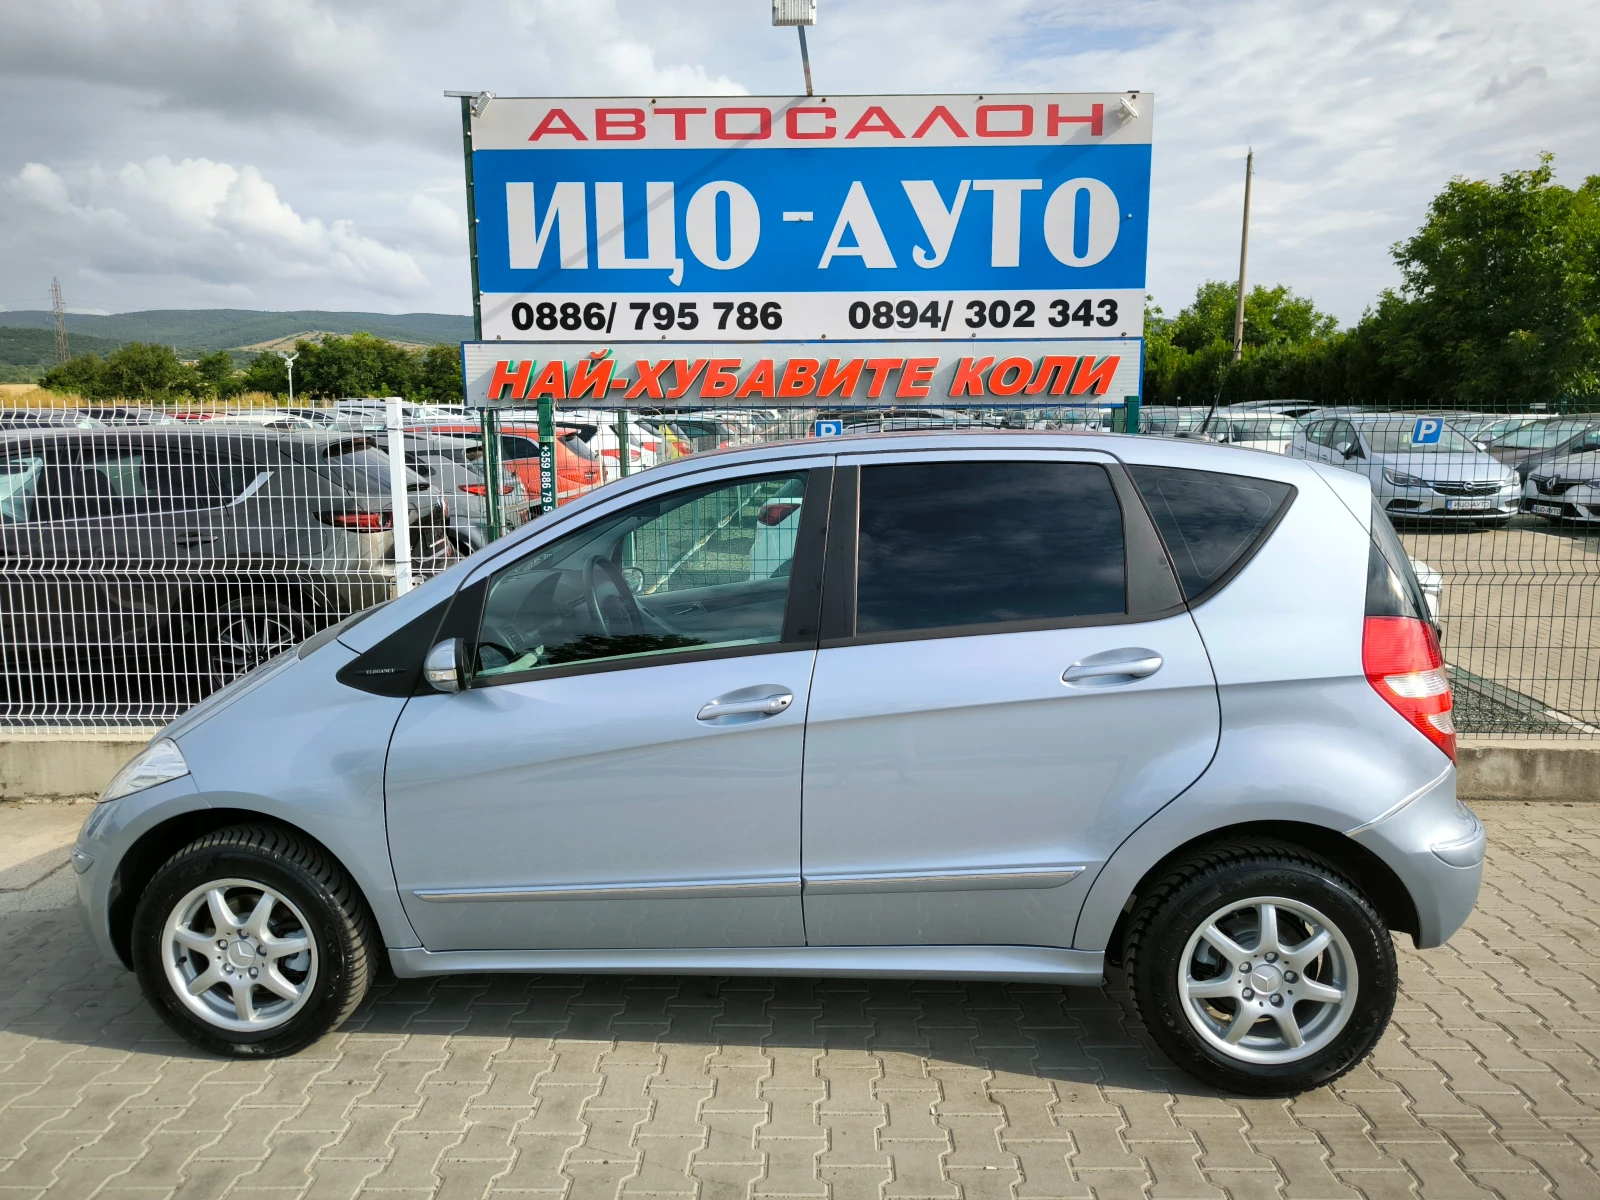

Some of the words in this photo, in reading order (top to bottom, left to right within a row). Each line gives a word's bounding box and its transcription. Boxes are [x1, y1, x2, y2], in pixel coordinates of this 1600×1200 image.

[527, 103, 1104, 141] АВТОСАЛОН
[505, 180, 761, 287] ИЦО
[511, 301, 617, 333] 0886/
[629, 301, 699, 330] 795
[712, 301, 783, 330] 786
[848, 300, 953, 331] 0894/
[964, 299, 1036, 328] 302
[1047, 299, 1119, 327] 343
[486, 348, 941, 399] НАЙ-ХУБАВИТЕ
[947, 355, 1122, 397] КОЛИ
[1417, 420, 1438, 441] P
[540, 445, 551, 468] +359
[541, 471, 552, 489] 886
[542, 491, 553, 503] 79
